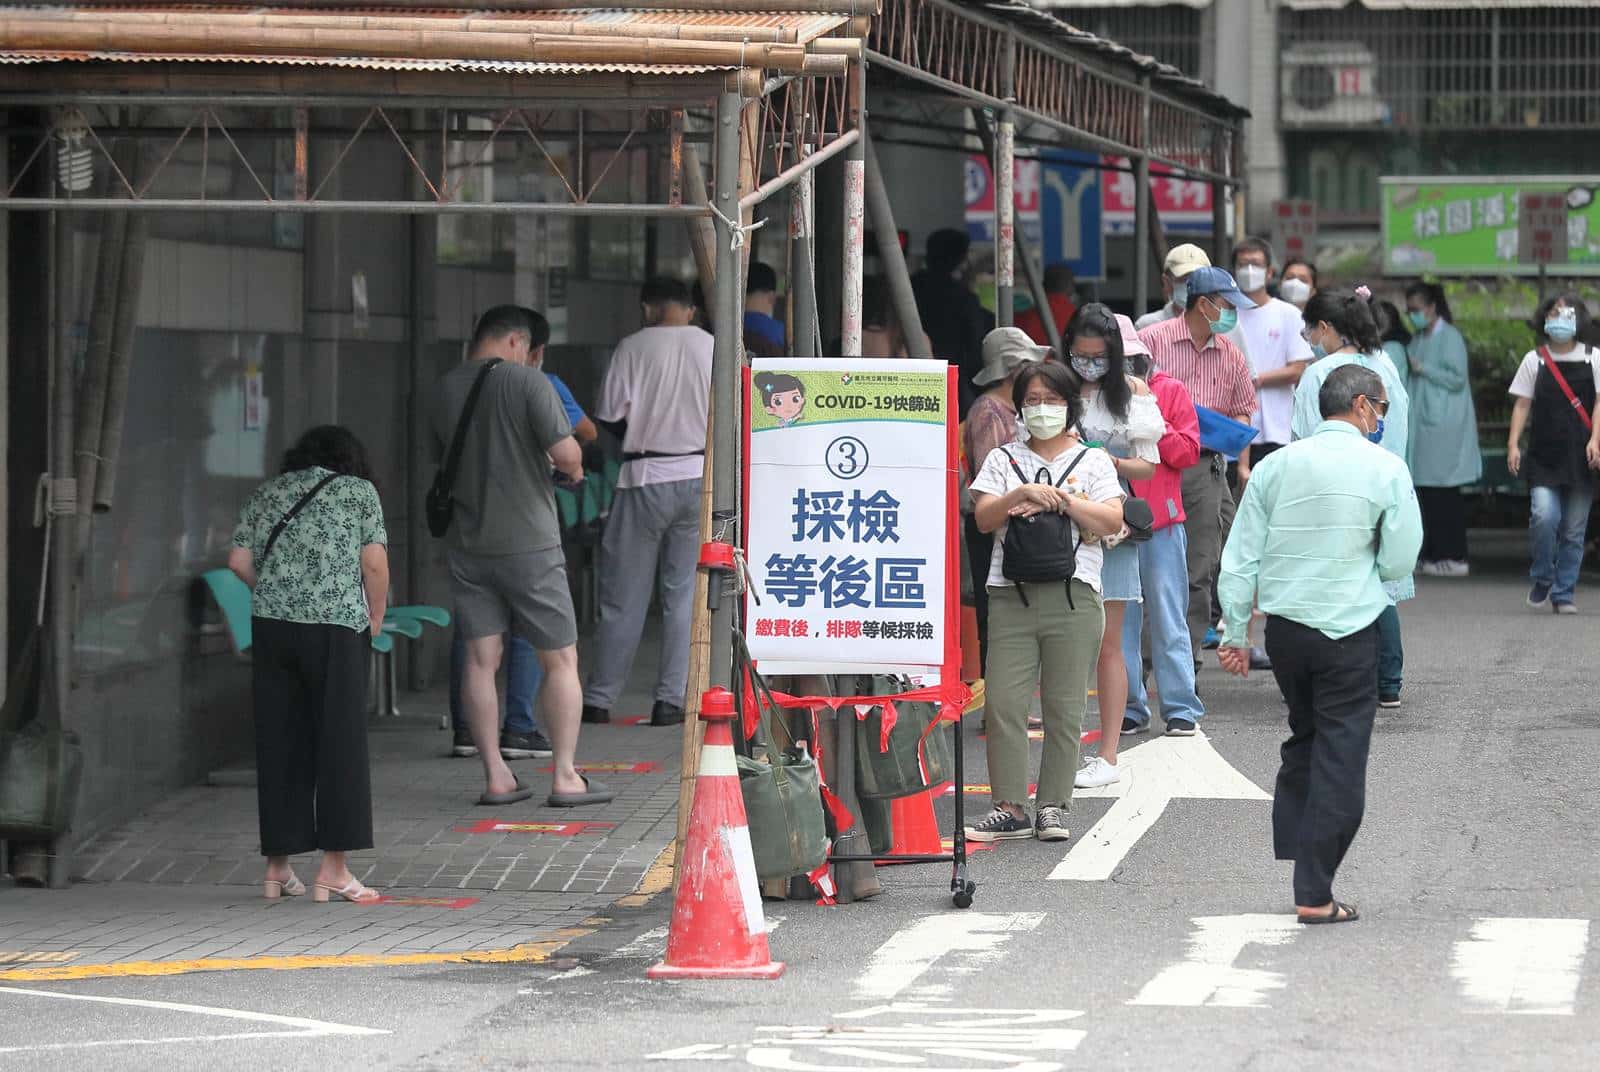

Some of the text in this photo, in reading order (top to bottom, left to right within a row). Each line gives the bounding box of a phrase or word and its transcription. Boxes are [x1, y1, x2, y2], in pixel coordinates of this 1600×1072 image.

[814, 393, 941, 413] COVID-19快篩站
[791, 488, 901, 544] 採檢
[764, 553, 927, 609] 等後區
